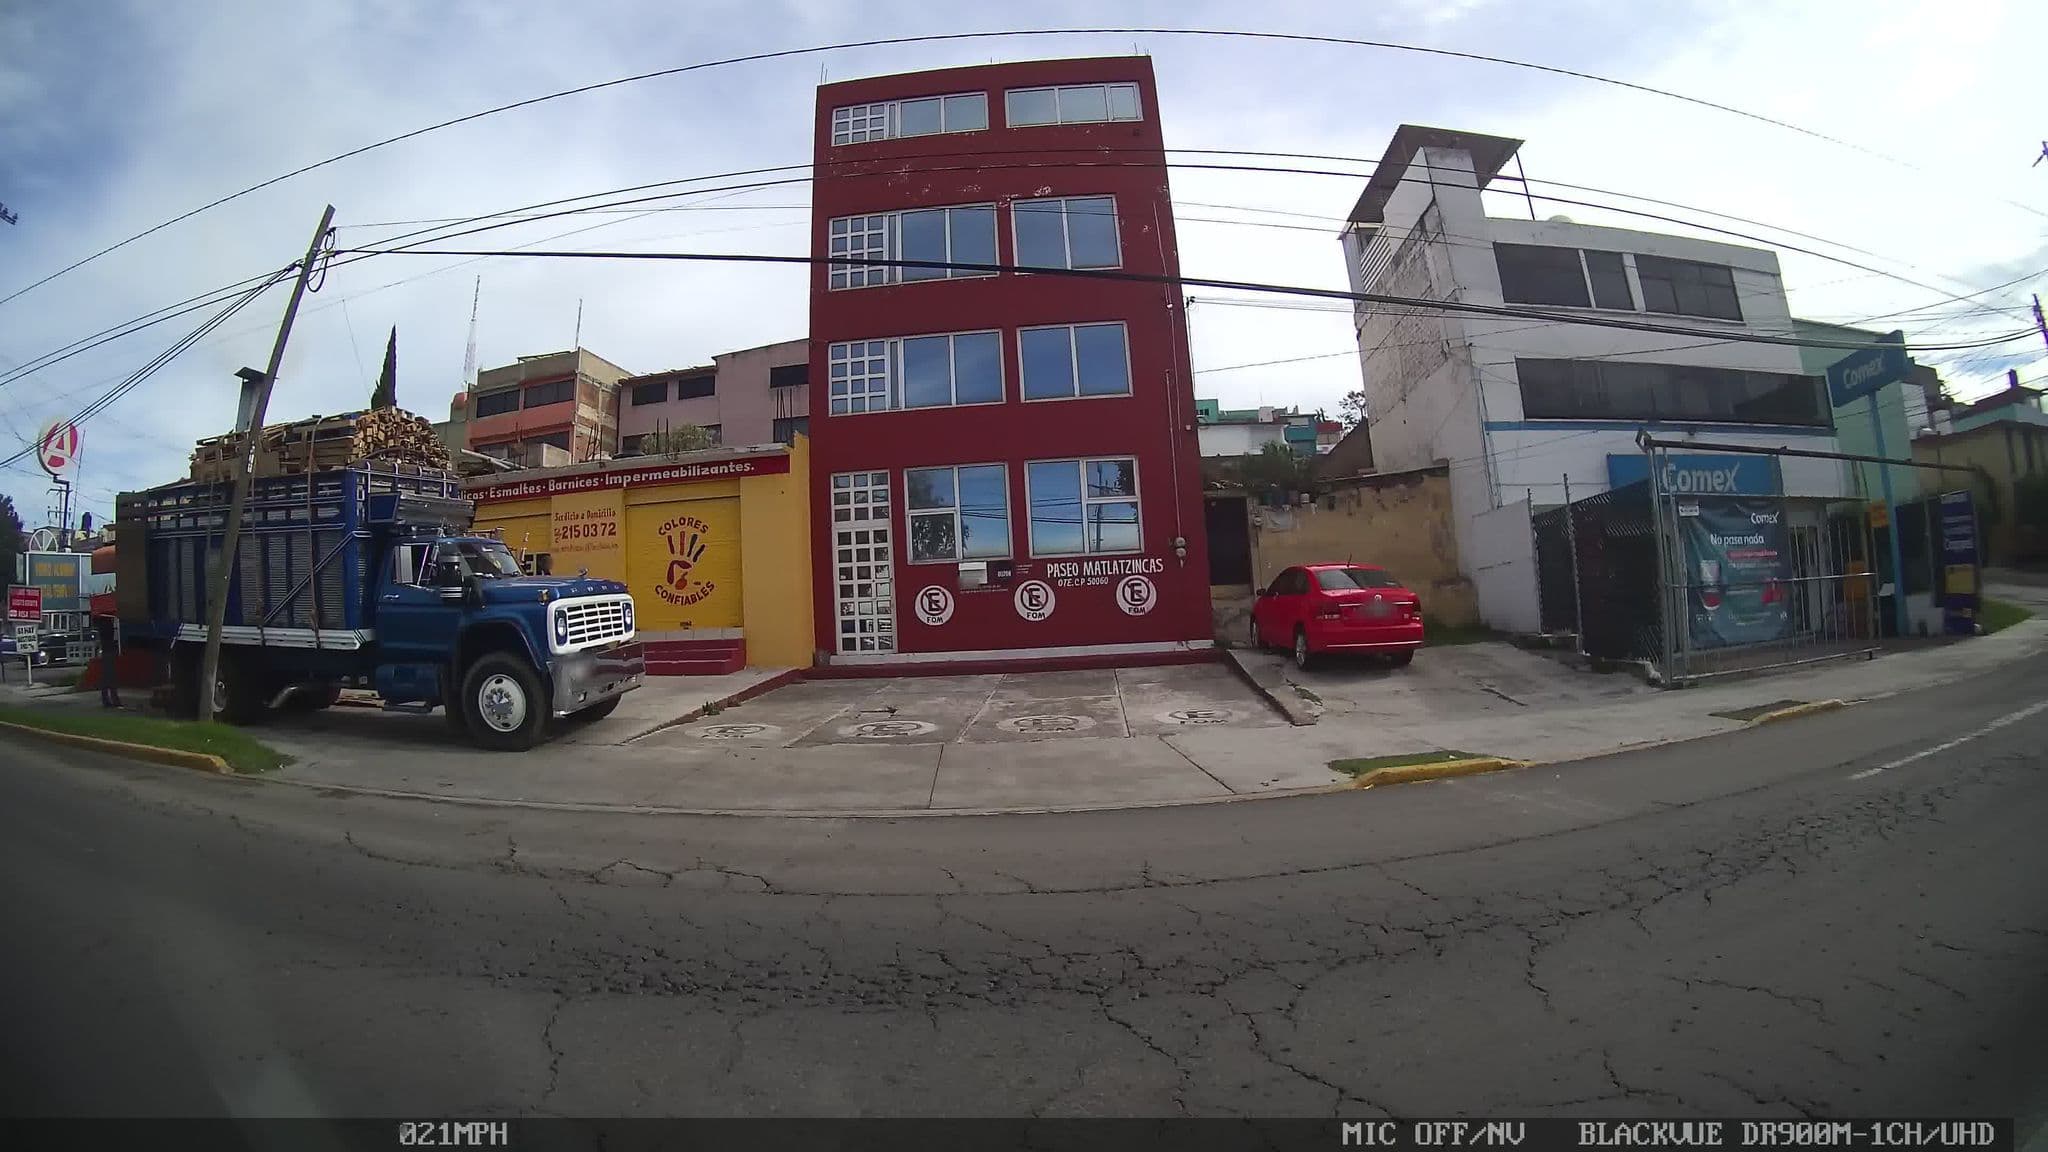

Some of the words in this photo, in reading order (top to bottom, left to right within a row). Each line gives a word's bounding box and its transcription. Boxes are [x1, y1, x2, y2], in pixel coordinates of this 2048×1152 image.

[1842, 351, 1886, 389] Comex
[489, 483, 541, 498] Esmaltes
[549, 475, 599, 492] Barnices
[605, 461, 755, 487] Impermeabilizantes.
[1661, 461, 1740, 492] Comex
[658, 516, 709, 536] COLORES
[1750, 511, 1779, 524] Comex
[1710, 533, 1722, 545] No
[1724, 535, 1743, 547] pasa
[1744, 532, 1765, 546] nada
[1047, 562, 1079, 578] PASEO
[1083, 558, 1164, 576] MATLATZINCAS
[1087, 576, 1109, 586] 50060
[655, 580, 715, 606] CONFIABLES
[926, 615, 944, 624] FOM
[1026, 611, 1046, 620] FOM
